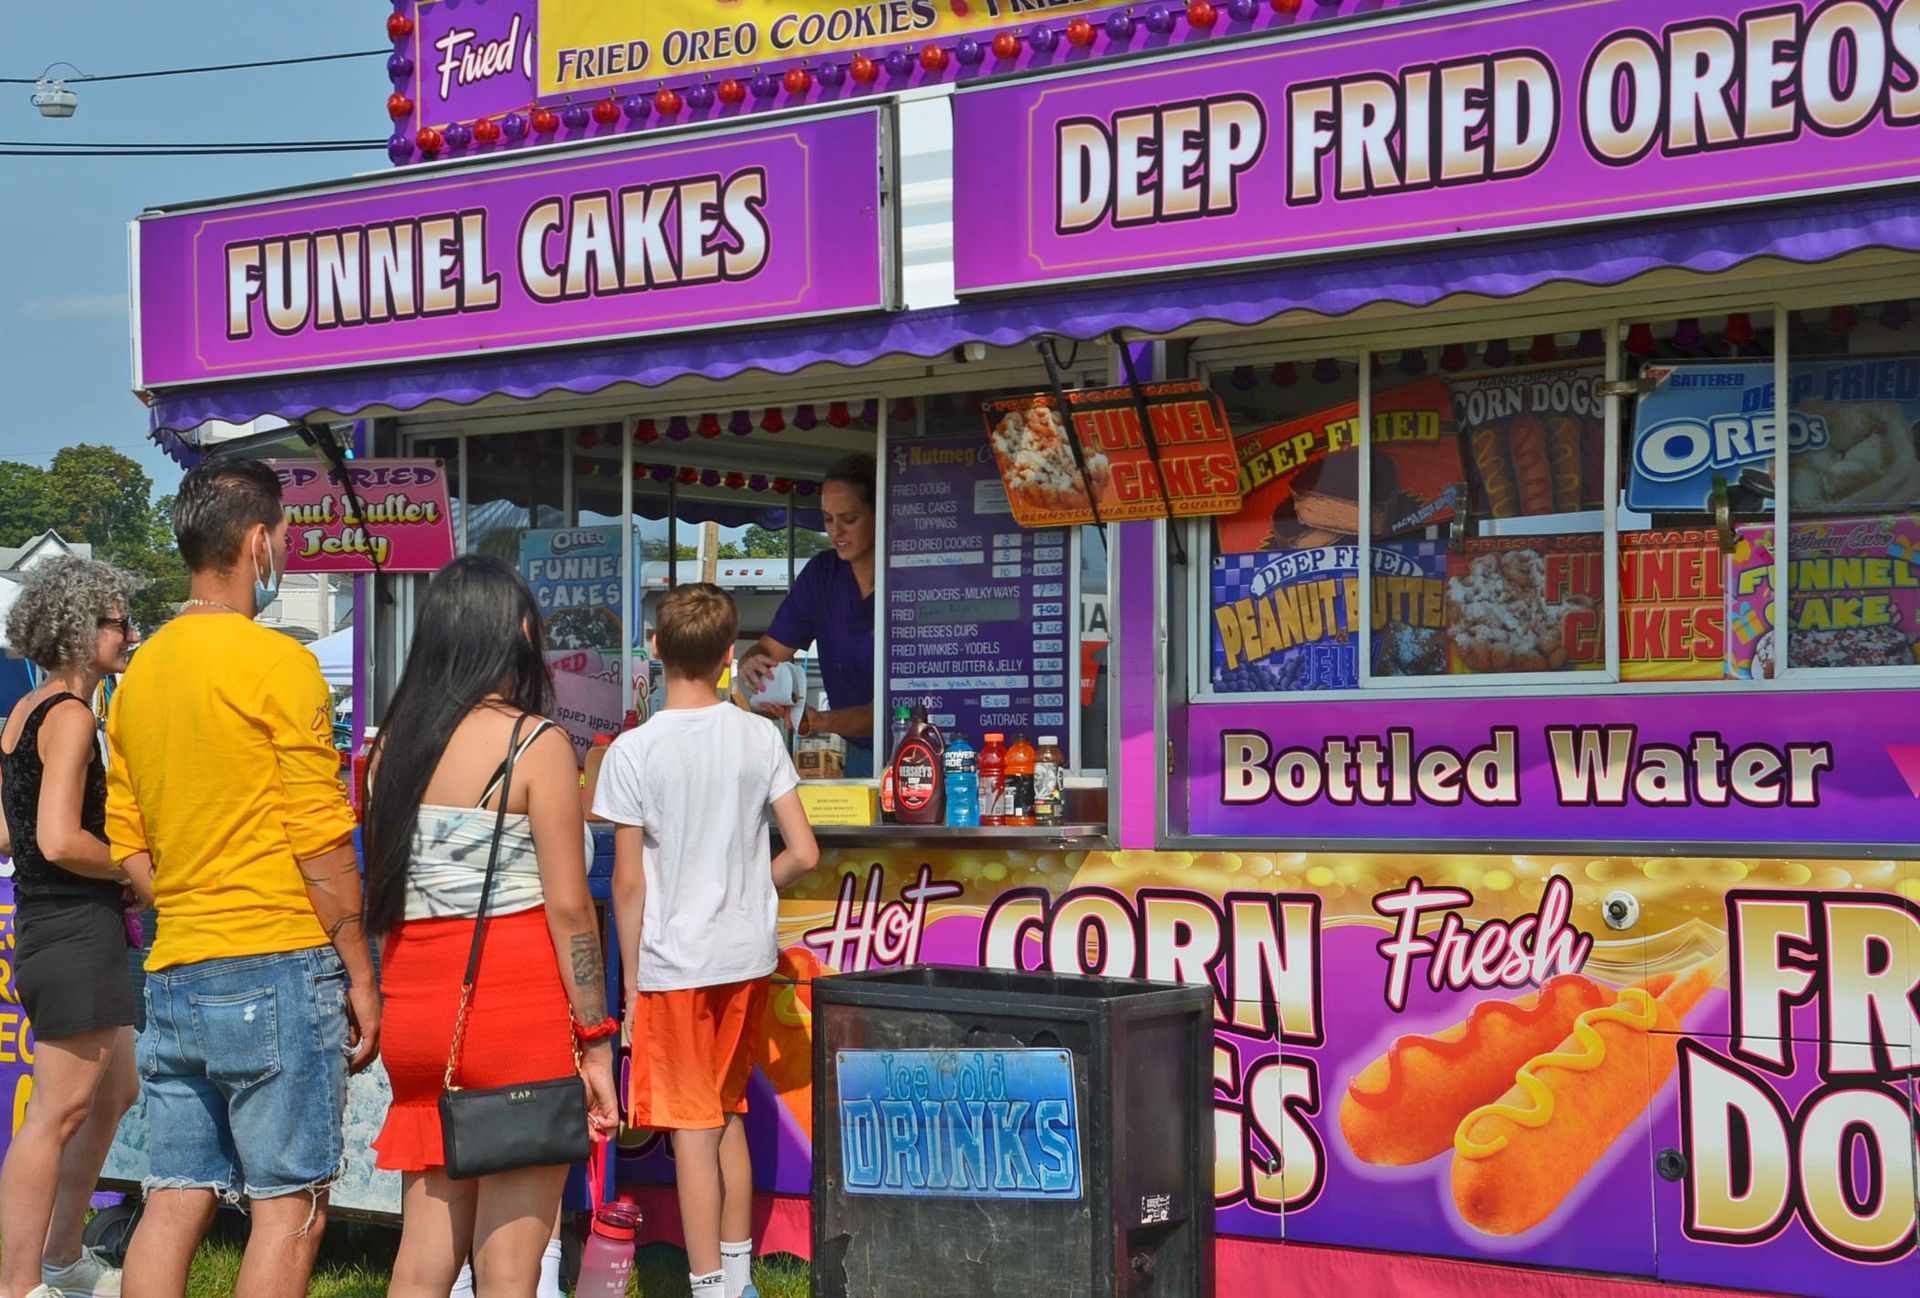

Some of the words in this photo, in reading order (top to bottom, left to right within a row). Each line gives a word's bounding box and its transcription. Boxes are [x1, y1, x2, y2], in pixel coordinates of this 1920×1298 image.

[556, 42, 648, 83] FRIED
[662, 21, 757, 62] OREO
[769, 0, 936, 46] COOKIES
[435, 14, 520, 100] Fried
[1058, 96, 1268, 234] DEEP
[1287, 50, 1558, 205] FRIED
[226, 209, 501, 340] FUNNEL
[518, 166, 770, 301] CAKES
[1671, 374, 1744, 387] BATTERED
[1742, 376, 1814, 412] DEP
[1824, 361, 1919, 400] FRIED
[1454, 383, 1523, 432] CORN
[1071, 399, 1227, 450] FUNNEL
[910, 447, 976, 466] Nutmeg
[893, 484, 919, 497] FRIED
[919, 482, 951, 496] DOUGH
[1108, 453, 1242, 505] CAKES
[284, 494, 337, 524] nut
[893, 504, 927, 517] FUNNEL
[928, 501, 958, 515] CAKES
[1128, 501, 1169, 515] DUTC
[914, 518, 958, 531] TOPPINGS
[299, 527, 390, 564] Jelly
[552, 531, 607, 551] OREO
[892, 541, 917, 552] FRIED
[918, 538, 945, 551] OREO
[944, 536, 983, 549] COOKIES
[1467, 539, 1547, 552] FRESH
[1553, 530, 1720, 549] HOEMADE
[1260, 550, 1325, 588] DEEP
[537, 583, 621, 609] CAKES
[892, 590, 916, 602] FRIED
[917, 588, 960, 601] SNICKERS
[965, 588, 993, 600] MILKY
[994, 586, 1020, 598] WAYS
[892, 609, 914, 621] FRIED
[1216, 578, 1338, 671] PEANUT
[1343, 575, 1447, 632] BUTTE
[892, 626, 916, 639] FRIED
[917, 625, 952, 638] REESE'S
[954, 624, 978, 636] CUPS
[892, 644, 916, 657] FRIED
[918, 642, 959, 656] TWINKIES
[965, 641, 1000, 654] YODELS
[892, 662, 916, 674] FRIED
[917, 660, 952, 674] PEANUT
[952, 659, 986, 672] BUTTER
[987, 659, 995, 671] &
[996, 659, 1023, 672] JELLY
[557, 707, 586, 723] cards
[980, 714, 1029, 727] GATORADE
[899, 766, 932, 778] HERSHEY'S
[1221, 726, 1520, 806] Bottled
[1546, 724, 1832, 806] Water
[806, 864, 962, 974] Hot
[980, 888, 1325, 1046] CORN
[1374, 876, 1594, 1012] Fresh
[882, 1055, 928, 1100] Ice
[938, 1053, 1007, 1101] Cold
[841, 1099, 1077, 1191] DRINKS
